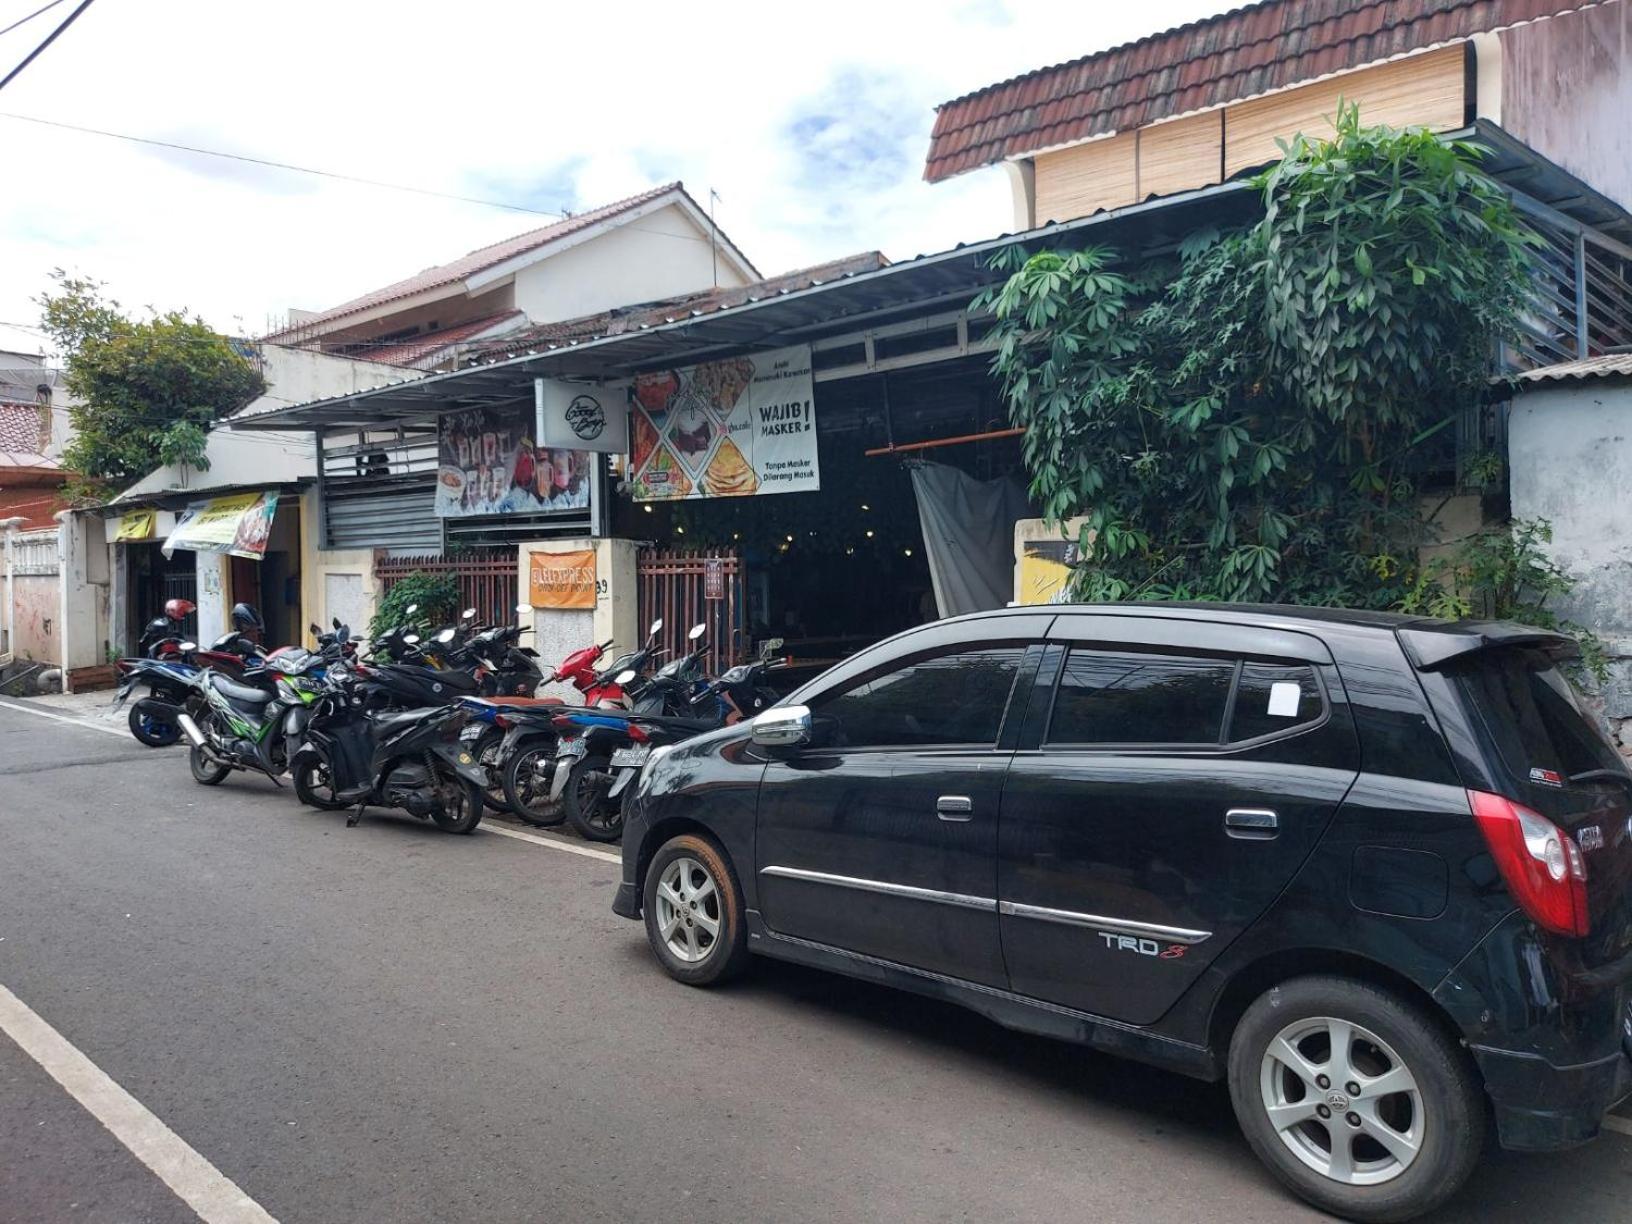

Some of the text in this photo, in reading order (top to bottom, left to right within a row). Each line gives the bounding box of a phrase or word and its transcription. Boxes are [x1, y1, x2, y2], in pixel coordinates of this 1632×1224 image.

[759, 402, 802, 422] WAJIB
[761, 422, 801, 438] MASKER
[787, 460, 811, 469] Masker
[793, 470, 815, 479] Masuk
[1098, 932, 1158, 956] TRD
